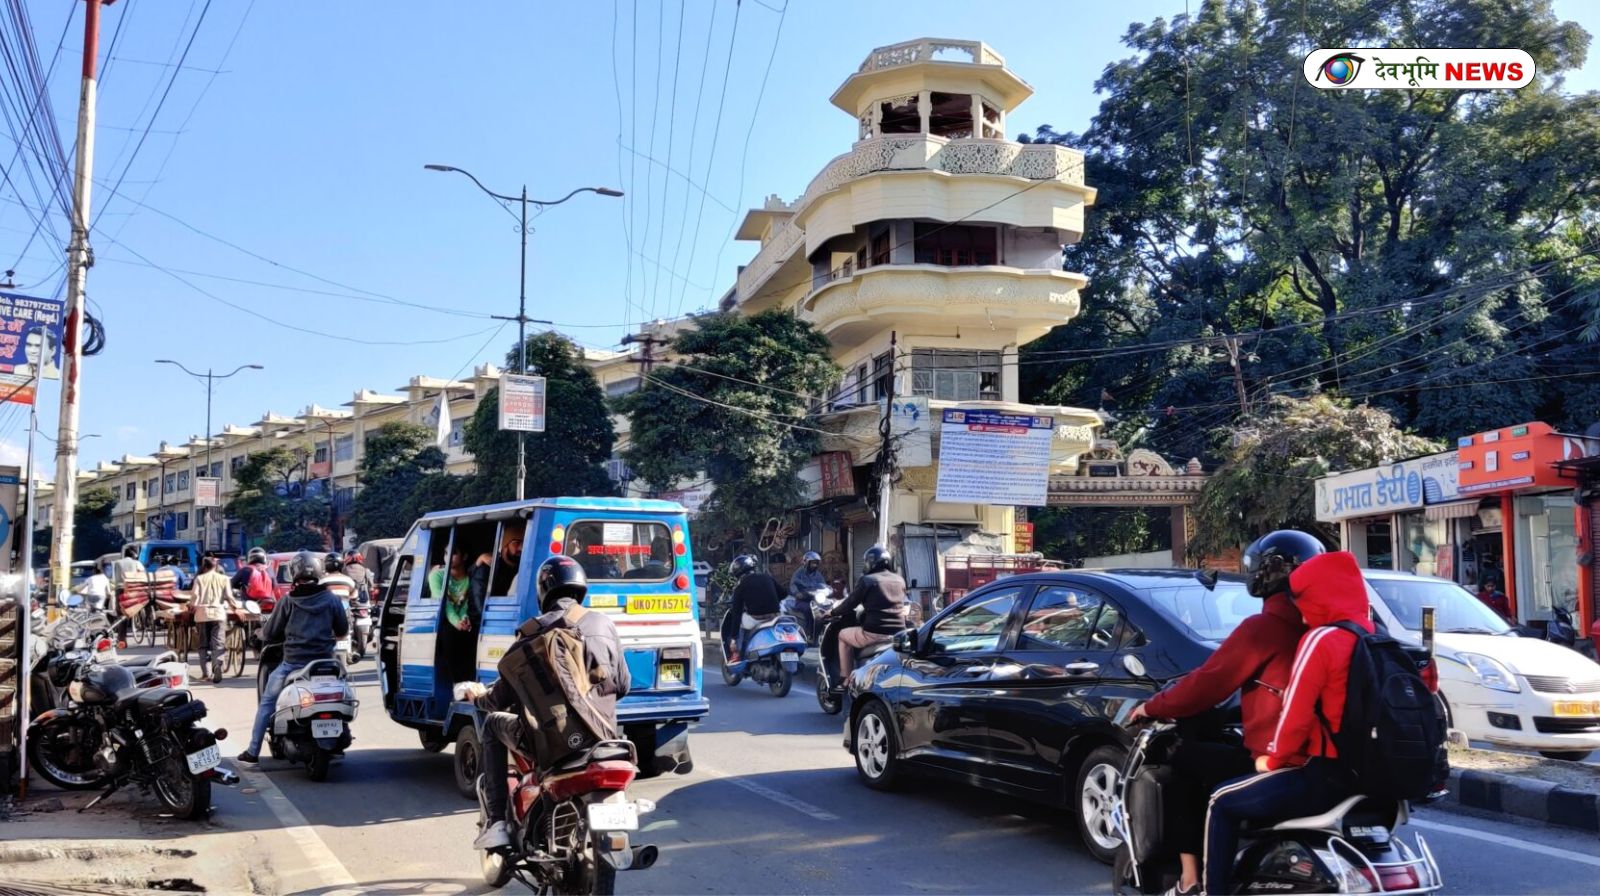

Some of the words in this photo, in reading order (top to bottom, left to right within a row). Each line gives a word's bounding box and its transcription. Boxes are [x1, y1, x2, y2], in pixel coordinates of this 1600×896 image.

[13, 307, 33, 320] CARE
[1333, 482, 1373, 515] प्रभात
[1375, 464, 1406, 505] डेरी
[633, 598, 690, 611] UK07TA5714
[1249, 881, 1294, 890] Activa
